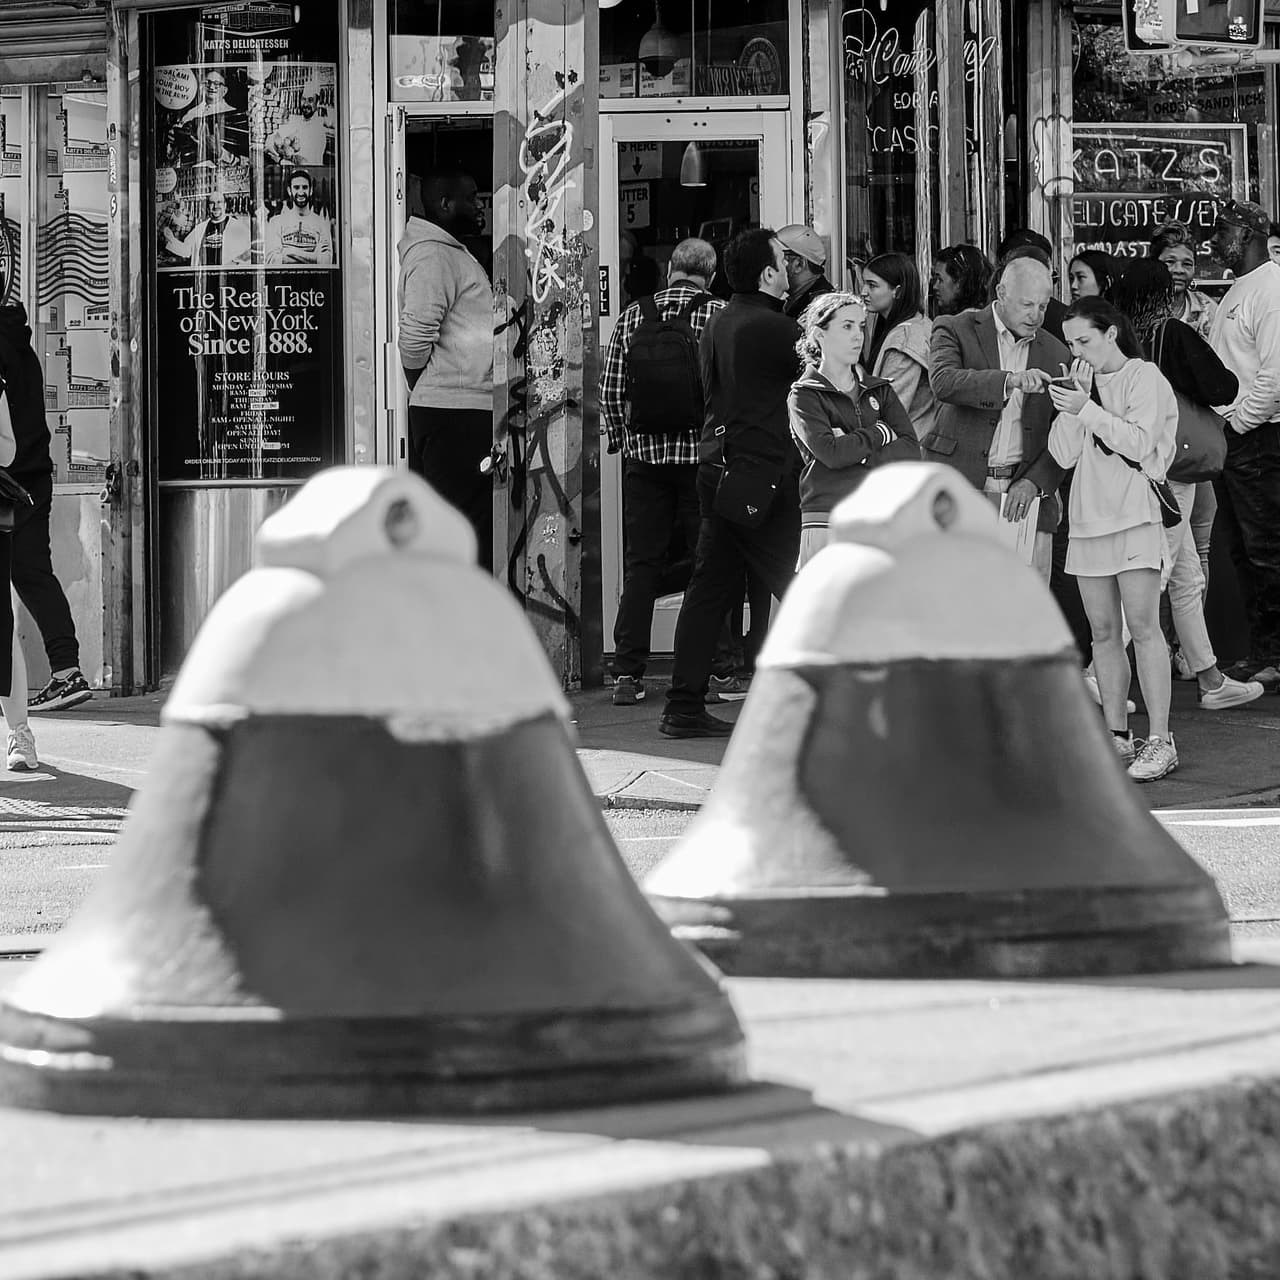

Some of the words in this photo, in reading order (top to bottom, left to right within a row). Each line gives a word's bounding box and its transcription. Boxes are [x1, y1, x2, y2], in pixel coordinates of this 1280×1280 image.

[203, 39, 231, 50] KATZ'S
[233, 38, 289, 49] DELICATESSEN
[627, 204, 636, 224] 5
[173, 287, 215, 310] The
[220, 285, 269, 308] Real
[274, 285, 325, 308] Taste
[599, 269, 609, 314] PULL
[180, 309, 205, 333] of
[207, 310, 260, 332] New
[265, 308, 319, 331] York.
[188, 333, 250, 356] Since
[214, 372, 252, 382] STORE
[253, 371, 290, 381] HOURS
